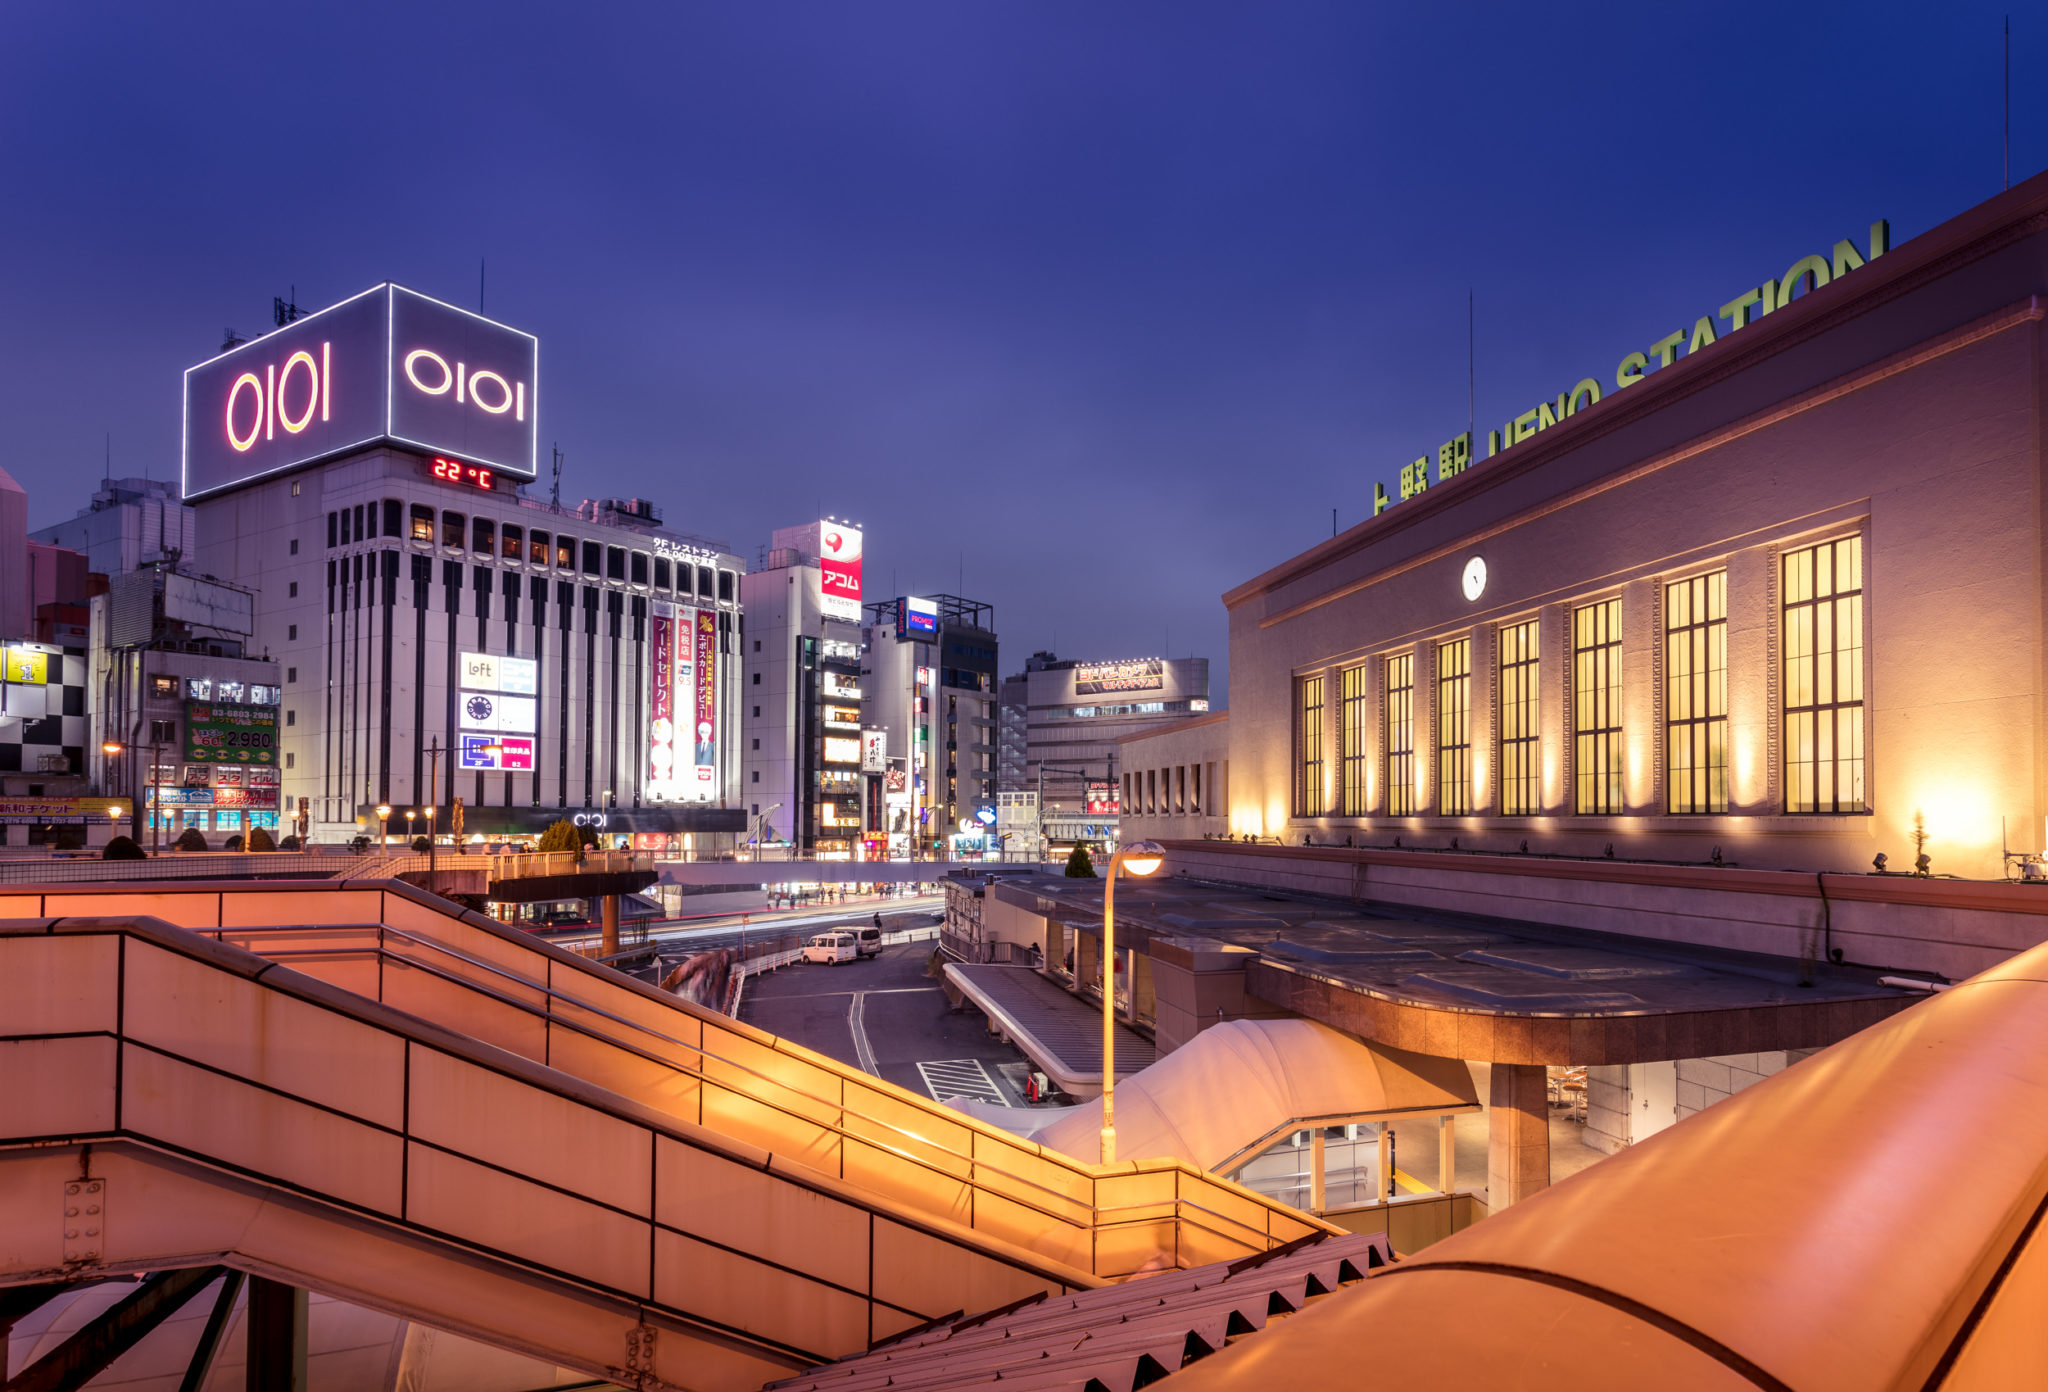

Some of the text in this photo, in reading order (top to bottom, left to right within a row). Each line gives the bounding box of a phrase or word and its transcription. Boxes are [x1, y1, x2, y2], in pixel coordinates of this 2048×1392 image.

[1489, 378, 1602, 457] UENO
[1616, 219, 1889, 388] STATION
[434, 458, 460, 480] 22
[653, 537, 720, 559] 9F レストラン
[824, 570, 859, 590] アコム
[911, 615, 934, 626] PROMISE
[680, 624, 690, 656] 免税店
[656, 619, 668, 716] フードセレクト
[698, 634, 706, 718] エポスカードデビュー
[1080, 663, 1148, 681] ヨドバシカメラ
[0, 804, 75, 814] 新和チケット
